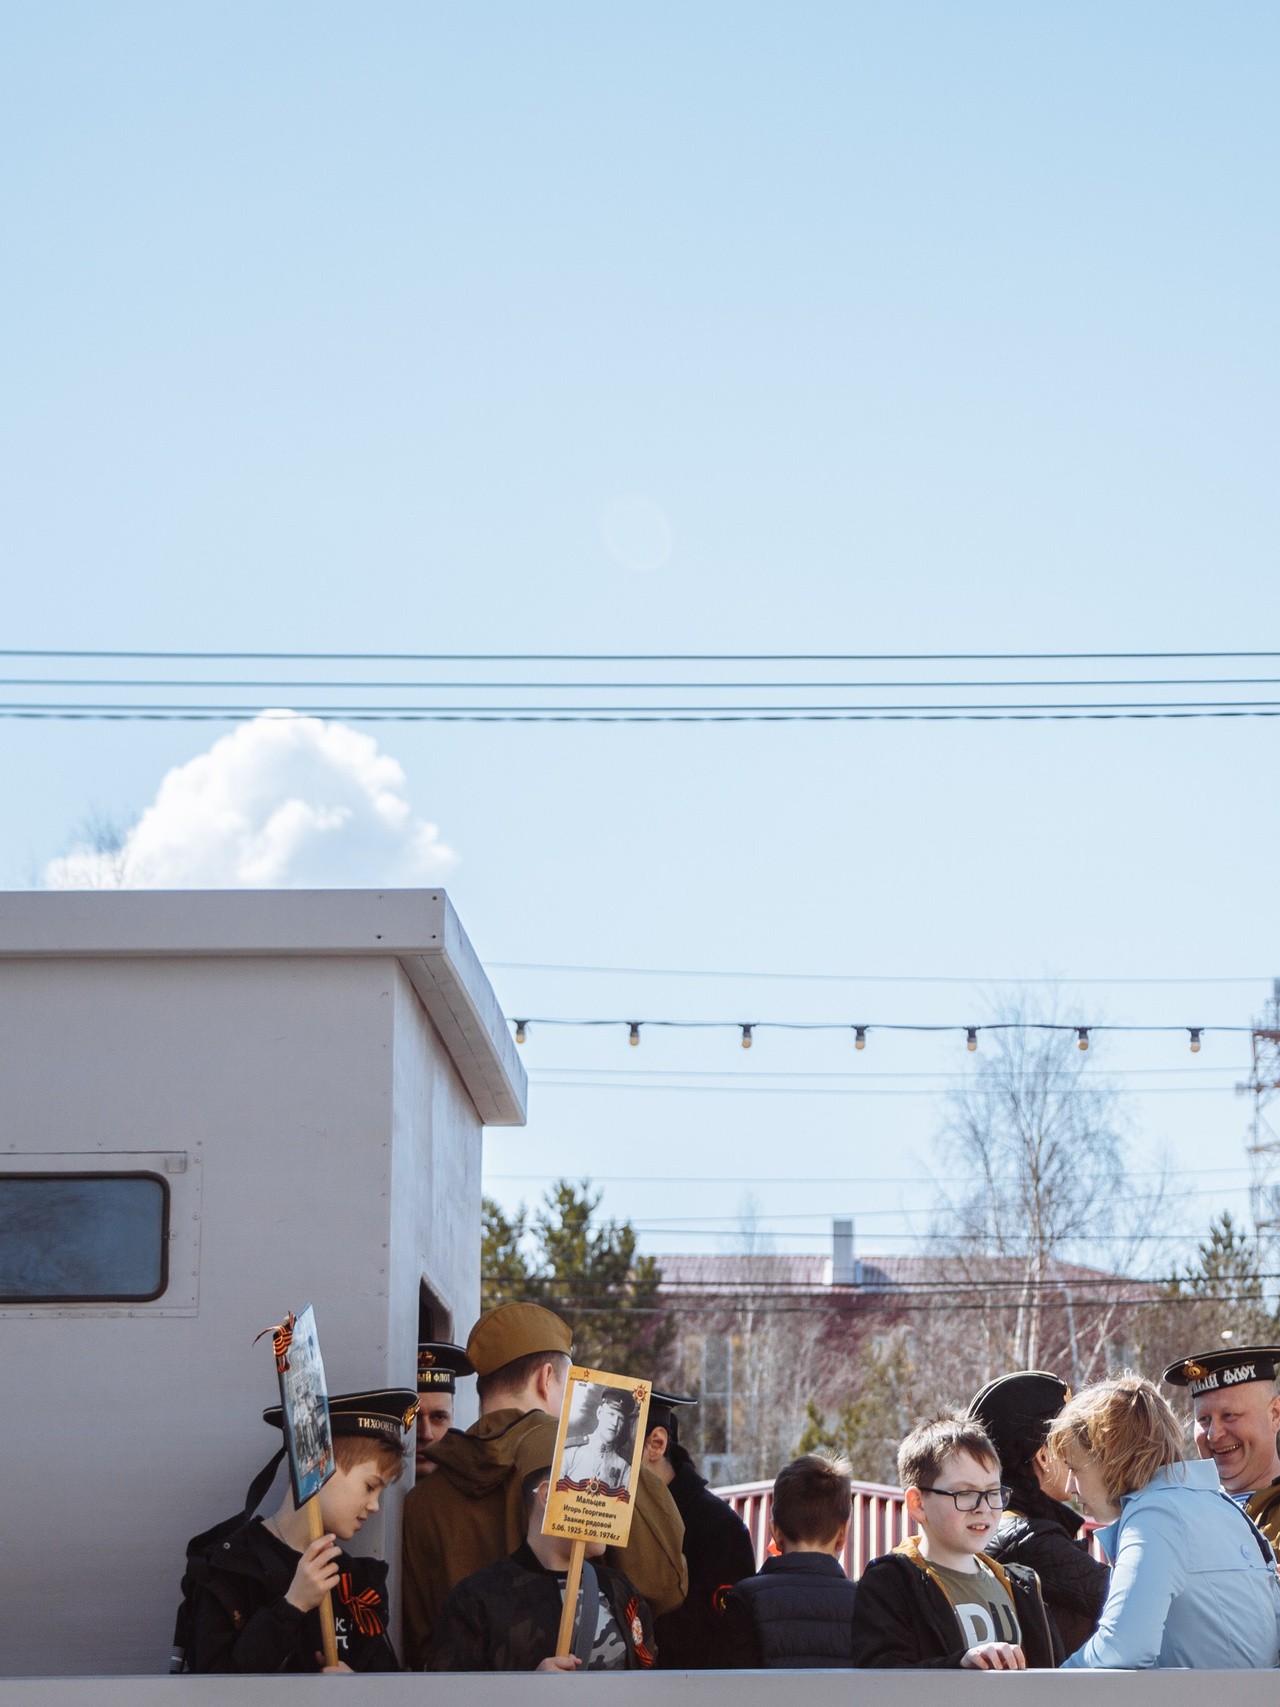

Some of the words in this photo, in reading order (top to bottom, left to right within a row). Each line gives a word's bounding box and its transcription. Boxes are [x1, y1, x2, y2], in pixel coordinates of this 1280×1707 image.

[433, 1373, 450, 1382] ФЛОТ
[1223, 1364, 1256, 1385] ФЛОТ
[576, 1495, 606, 1507] Мальцев
[563, 1504, 582, 1513] Игорь
[582, 1507, 617, 1519] Георгиевич
[563, 1514, 585, 1524] Звание
[585, 1519, 612, 1529] рядовой
[955, 1601, 1022, 1649] DU
